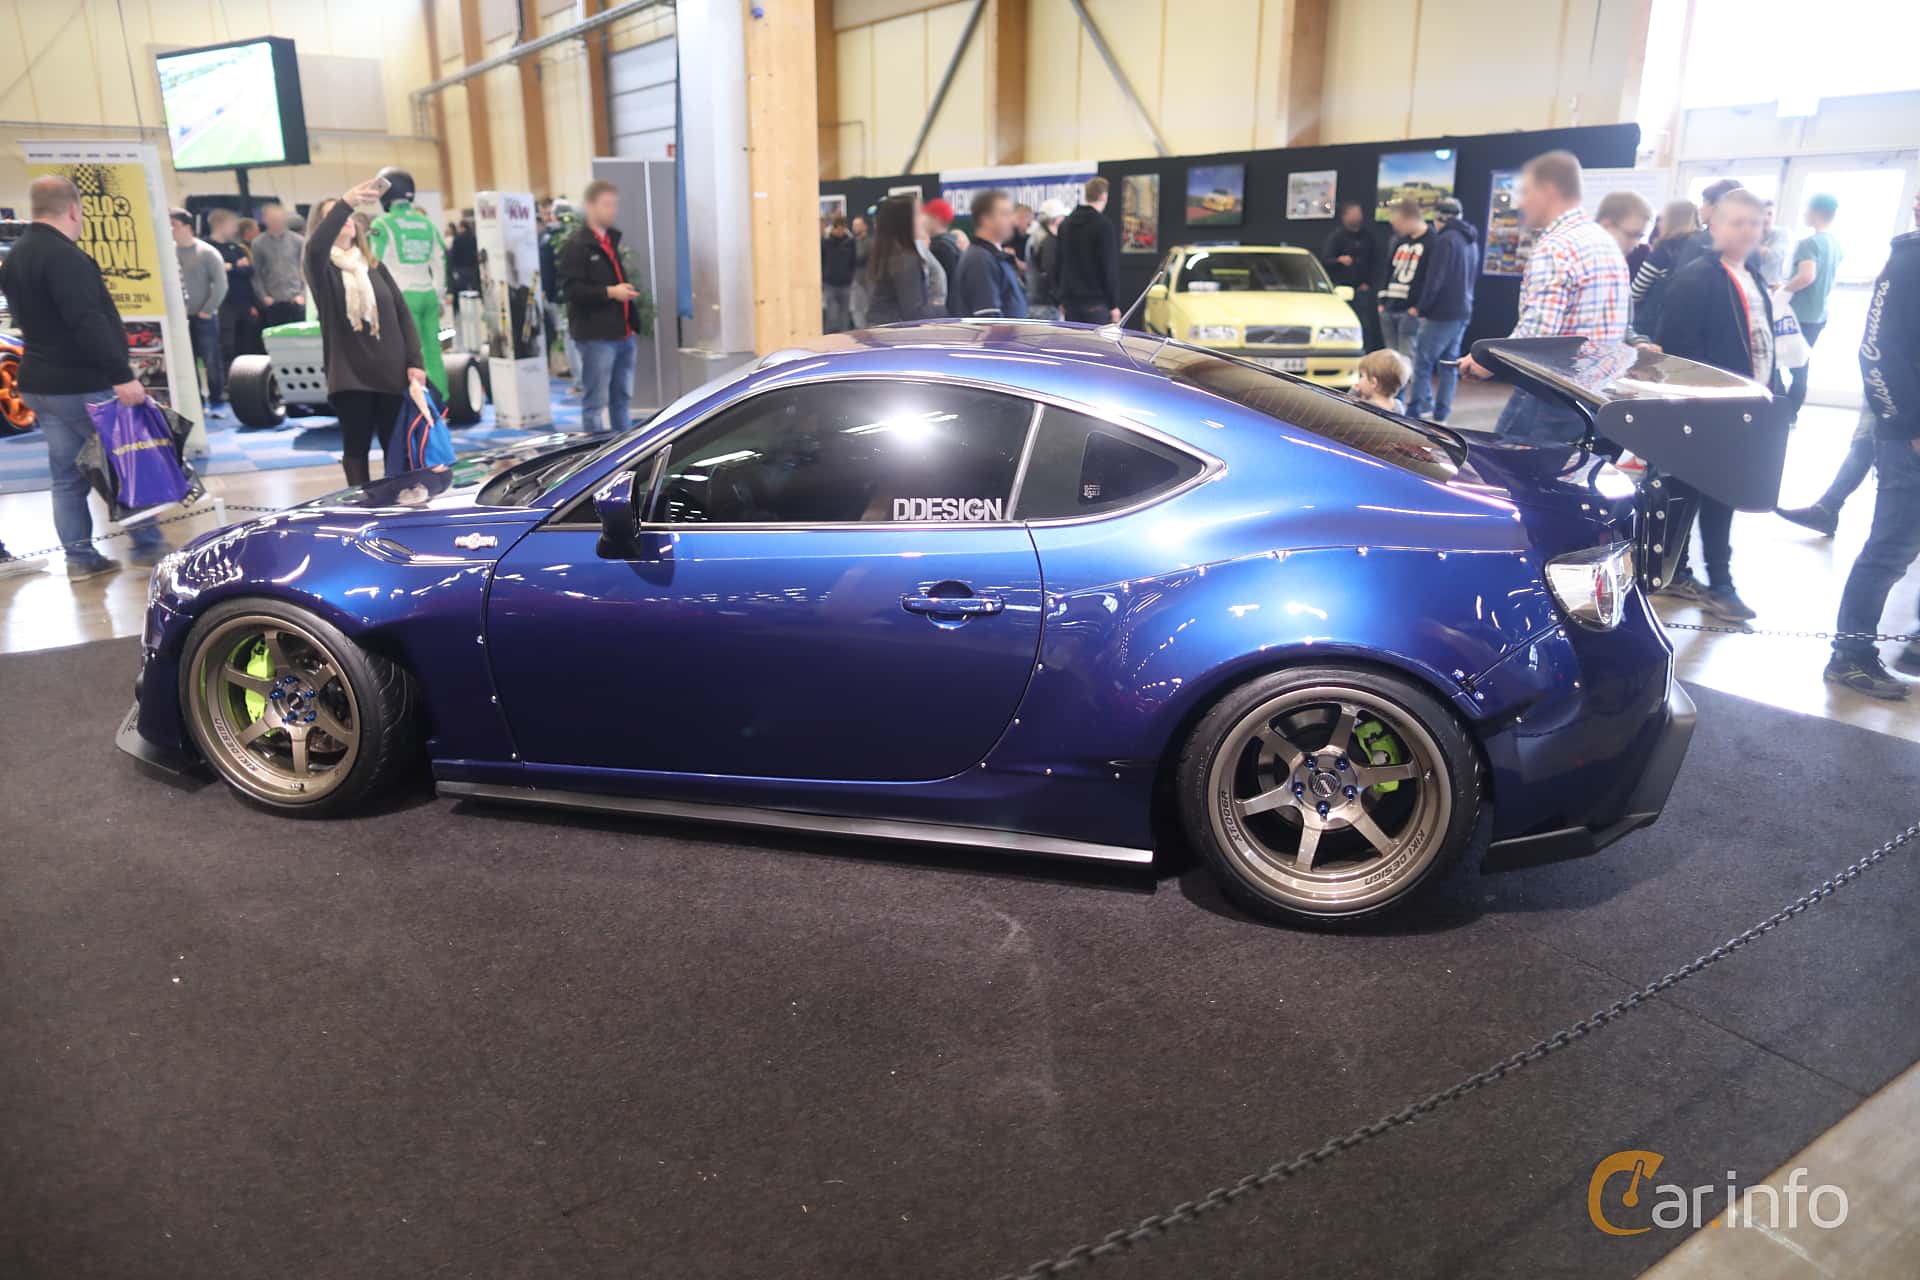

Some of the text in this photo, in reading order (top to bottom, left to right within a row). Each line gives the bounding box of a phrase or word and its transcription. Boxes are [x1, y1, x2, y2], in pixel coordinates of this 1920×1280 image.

[1861, 280, 1890, 361] Cruisers
[893, 498, 1002, 521] DDESIGN
[1364, 829, 1425, 886] KIKI DESIGN
